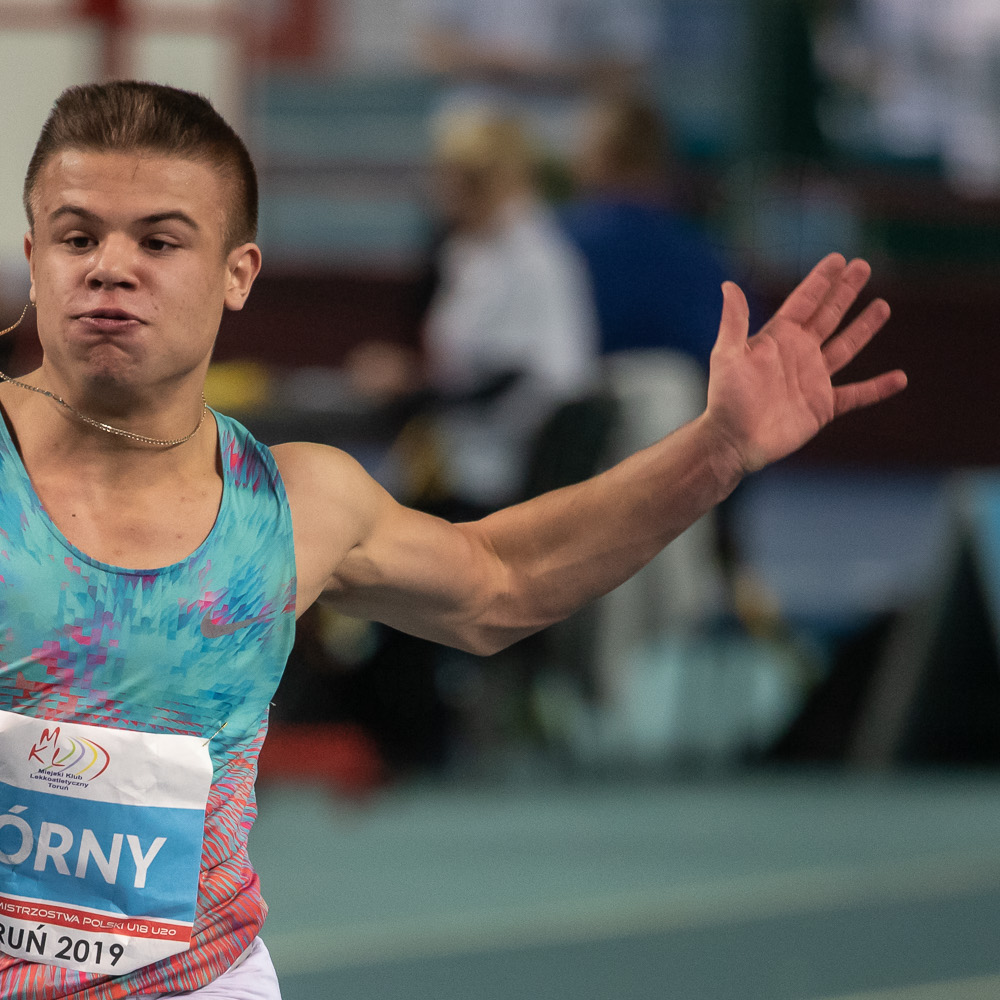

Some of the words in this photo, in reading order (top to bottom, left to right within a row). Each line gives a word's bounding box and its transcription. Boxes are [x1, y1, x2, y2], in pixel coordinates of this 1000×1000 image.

[29, 773, 89, 788] Lekkoatletyczny
[38, 768, 64, 778] Miejski
[65, 772, 83, 780] Klub
[47, 782, 69, 791] Toruń
[82, 916, 125, 931] POLSKI
[127, 922, 149, 934] U18
[151, 927, 178, 937] U20
[54, 935, 125, 967] 2019
